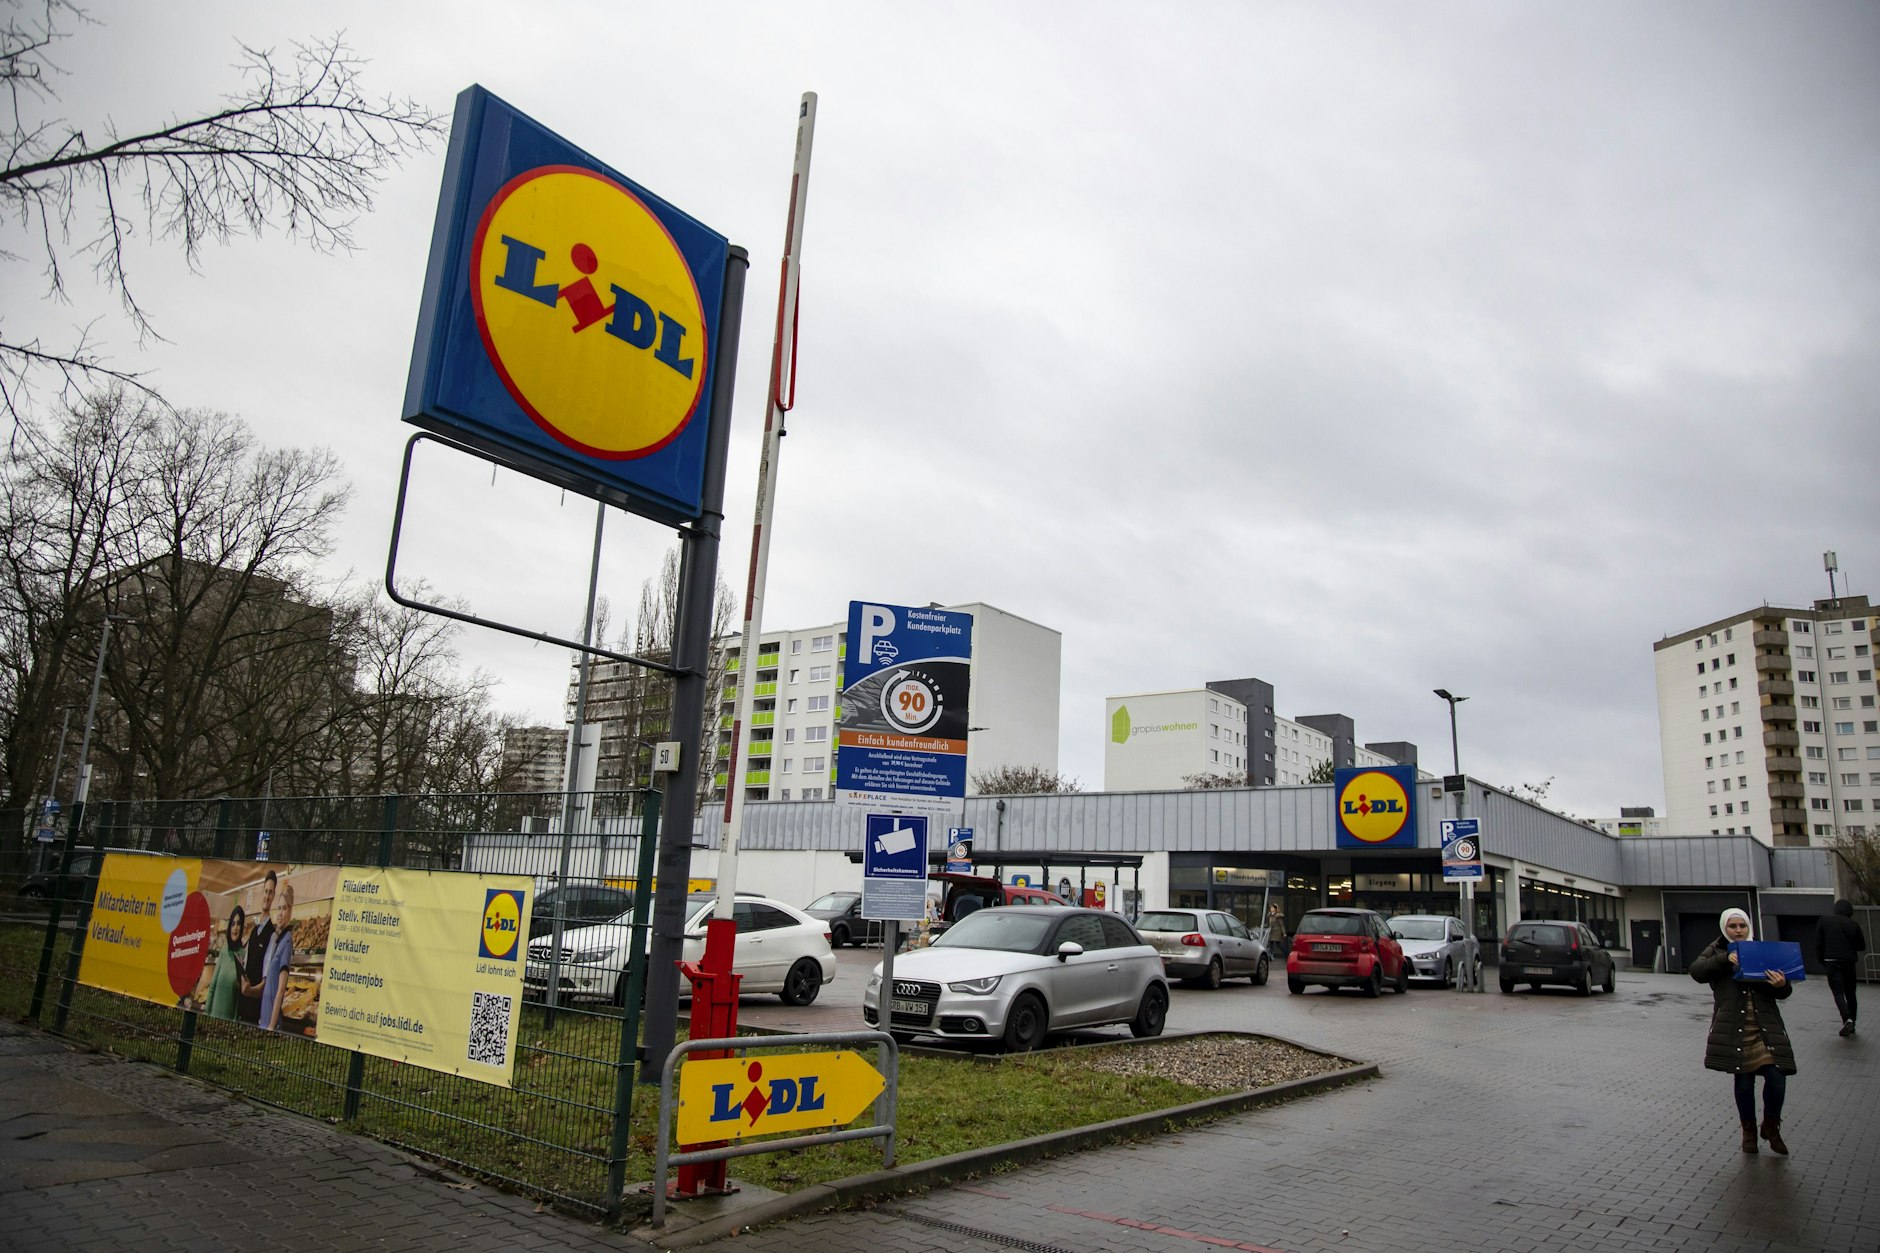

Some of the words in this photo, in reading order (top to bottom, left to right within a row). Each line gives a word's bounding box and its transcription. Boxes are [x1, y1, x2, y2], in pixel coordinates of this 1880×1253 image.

[907, 609, 946, 622] Kostenfreier
[858, 604, 896, 664] P
[907, 620, 962, 635] Kundenparkplatz
[905, 683, 920, 691] max.
[899, 691, 925, 712] 90
[905, 712, 918, 721] Min.
[1132, 722, 1198, 736] gropiuswohnen
[857, 734, 885, 746] Einfach
[886, 736, 949, 750] kundenfreundlich
[660, 749, 669, 764] 50
[1442, 822, 1454, 841] P
[342, 880, 380, 894] Filialleiter
[97, 891, 143, 915] Mitarbeiter
[144, 896, 157, 916] im
[338, 908, 359, 923] Stellv.
[360, 910, 400, 927] Filialleiter
[92, 921, 126, 945] Verkauf
[173, 929, 206, 947] Quereinsteiger
[171, 944, 200, 959] willkommen!
[333, 937, 370, 954] Verkäufer
[329, 967, 383, 989] Studentenjobs
[477, 964, 487, 973] Lidl
[488, 964, 503, 976] lohnt
[504, 966, 516, 978] sich
[325, 1002, 348, 1018] Bewirb
[349, 1007, 365, 1022] dich
[367, 1011, 379, 1024] auf
[379, 1012, 424, 1034] jobs.lidl.de
